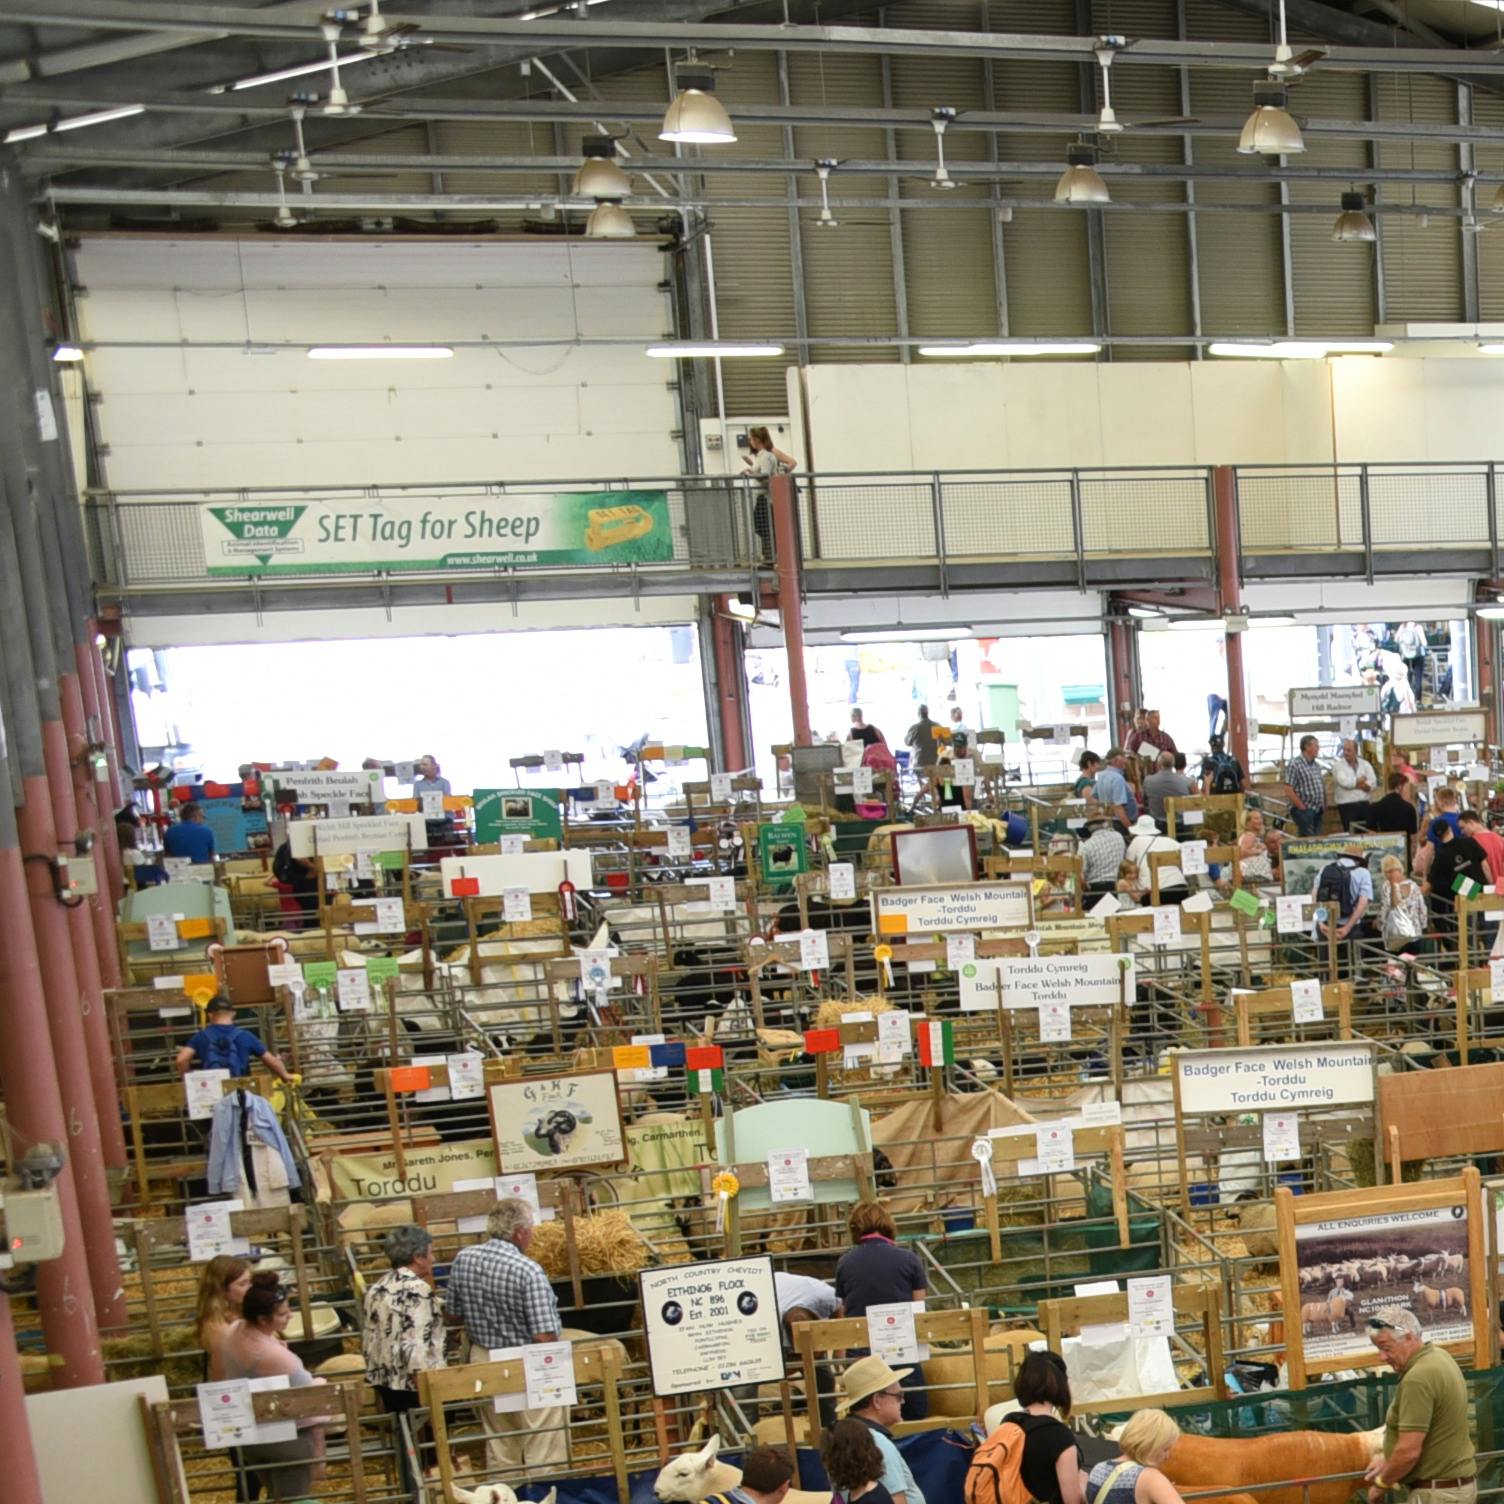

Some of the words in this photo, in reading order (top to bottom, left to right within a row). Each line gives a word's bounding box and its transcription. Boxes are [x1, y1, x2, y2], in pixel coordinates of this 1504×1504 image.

[224, 506, 295, 523] Shearwell
[244, 524, 279, 539] Data
[318, 513, 364, 543] SET
[369, 513, 413, 548] Tag
[419, 511, 458, 541] for
[464, 510, 541, 544] Sheep
[881, 897, 918, 908] Badger
[921, 894, 945, 904] Face
[950, 892, 981, 903] Welsh
[918, 916, 954, 927] Torddu
[956, 914, 998, 926] Cymreig
[1008, 963, 1044, 975] Torddu
[1046, 961, 1088, 976] Cymreig
[1014, 980, 1038, 991] Face
[1041, 978, 1072, 989] Welsh
[1032, 990, 1067, 1001] Torddu
[1184, 1064, 1231, 1077] Badger
[1235, 1060, 1266, 1073] Face
[1273, 1057, 1312, 1070] Welsh
[1257, 1073, 1307, 1087] -Torddu
[1231, 1090, 1276, 1104] Torddu
[1280, 1086, 1334, 1101] Cymreig
[1317, 1222, 1336, 1232] ALL
[1338, 1216, 1390, 1229] ENQUIRIES
[1390, 1210, 1440, 1223] WELCOME
[650, 1276, 678, 1289] NORTH
[684, 1268, 721, 1279] COUNTRY
[719, 1279, 745, 1292] FLOCK
[691, 1297, 703, 1307] NC
[709, 1294, 725, 1305] 896
[689, 1310, 706, 1321] Est.
[709, 1306, 729, 1317] 2001
